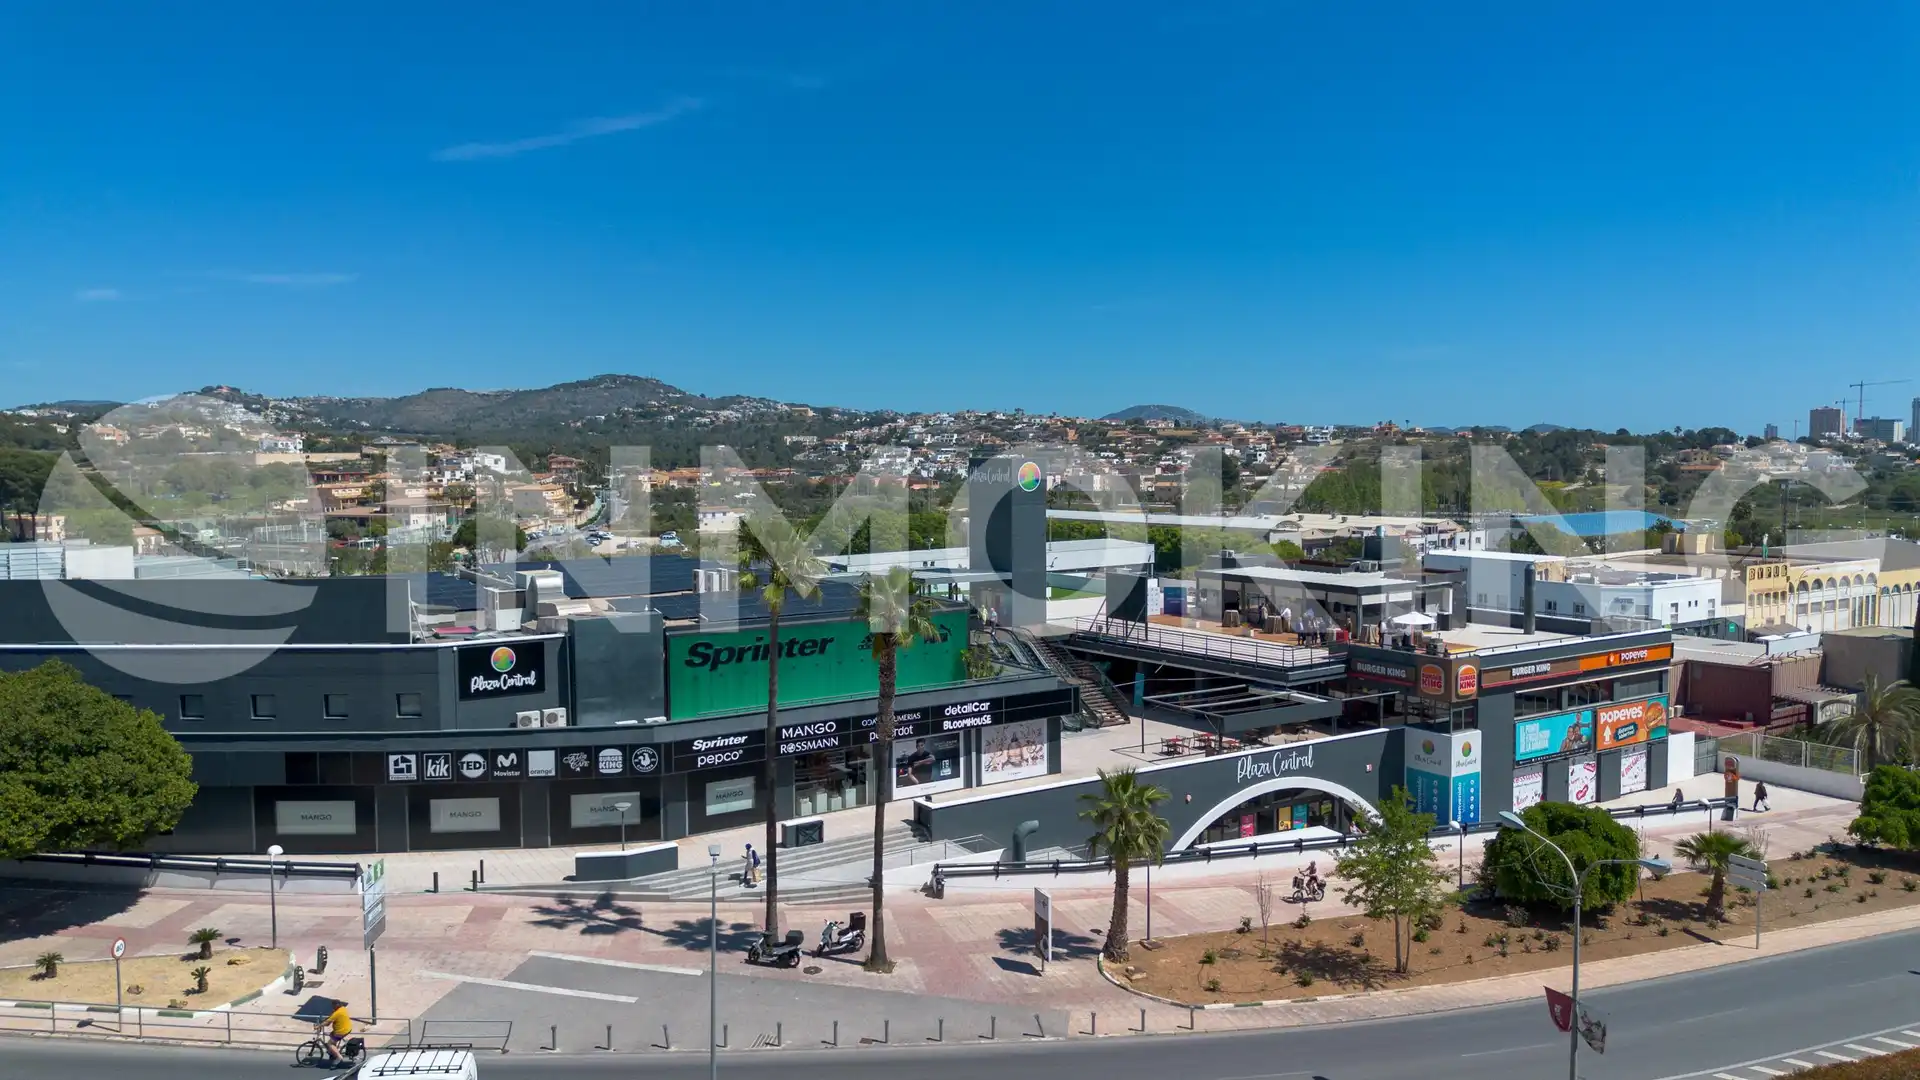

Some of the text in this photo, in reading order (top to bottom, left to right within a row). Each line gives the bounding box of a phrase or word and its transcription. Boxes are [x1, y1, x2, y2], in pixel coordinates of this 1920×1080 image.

[684, 636, 835, 672] Sprinter
[1356, 662, 1406, 678] BURGER KING
[1421, 672, 1442, 681] BURGER
[1511, 663, 1551, 677] BURGER KING
[471, 670, 536, 693] Plaza Central
[1421, 679, 1443, 689] KING
[1459, 674, 1476, 682] BURGER
[1459, 680, 1476, 690] KING
[944, 702, 991, 716] detailCar
[943, 714, 992, 730] BLOOMHOUSE
[781, 721, 836, 739] MANGO
[692, 735, 748, 751] Sprinter
[780, 736, 839, 754] ROSSMANN
[427, 756, 449, 777] kik
[458, 760, 487, 770] TEDi
[599, 760, 623, 769] KING
[697, 751, 740, 768] pepco
[1237, 745, 1314, 783] Plaza Central
[716, 790, 744, 800] MANGO
[589, 805, 619, 813] MANG
